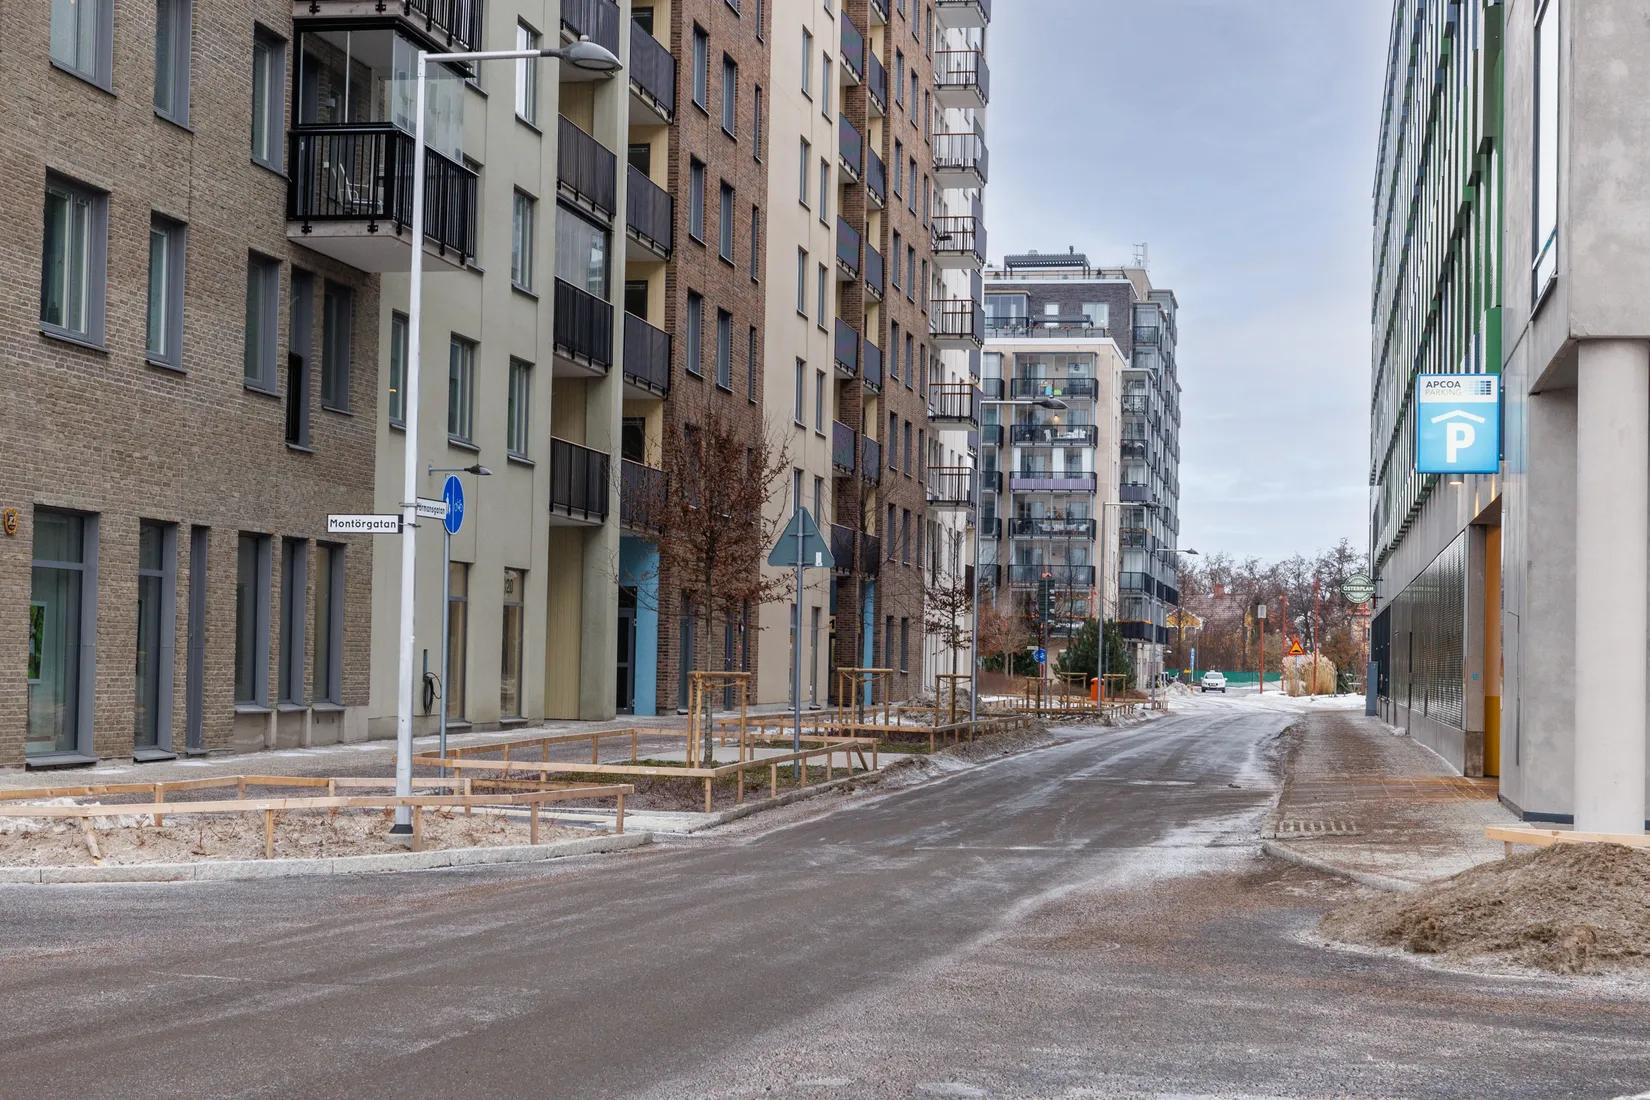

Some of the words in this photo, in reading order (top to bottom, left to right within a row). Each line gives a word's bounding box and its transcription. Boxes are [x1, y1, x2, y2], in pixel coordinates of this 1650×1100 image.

[1425, 380, 1462, 389] APCOA
[1425, 388, 1462, 396] PARKING
[1446, 422, 1476, 464] P
[330, 519, 396, 530] Montörgatan
